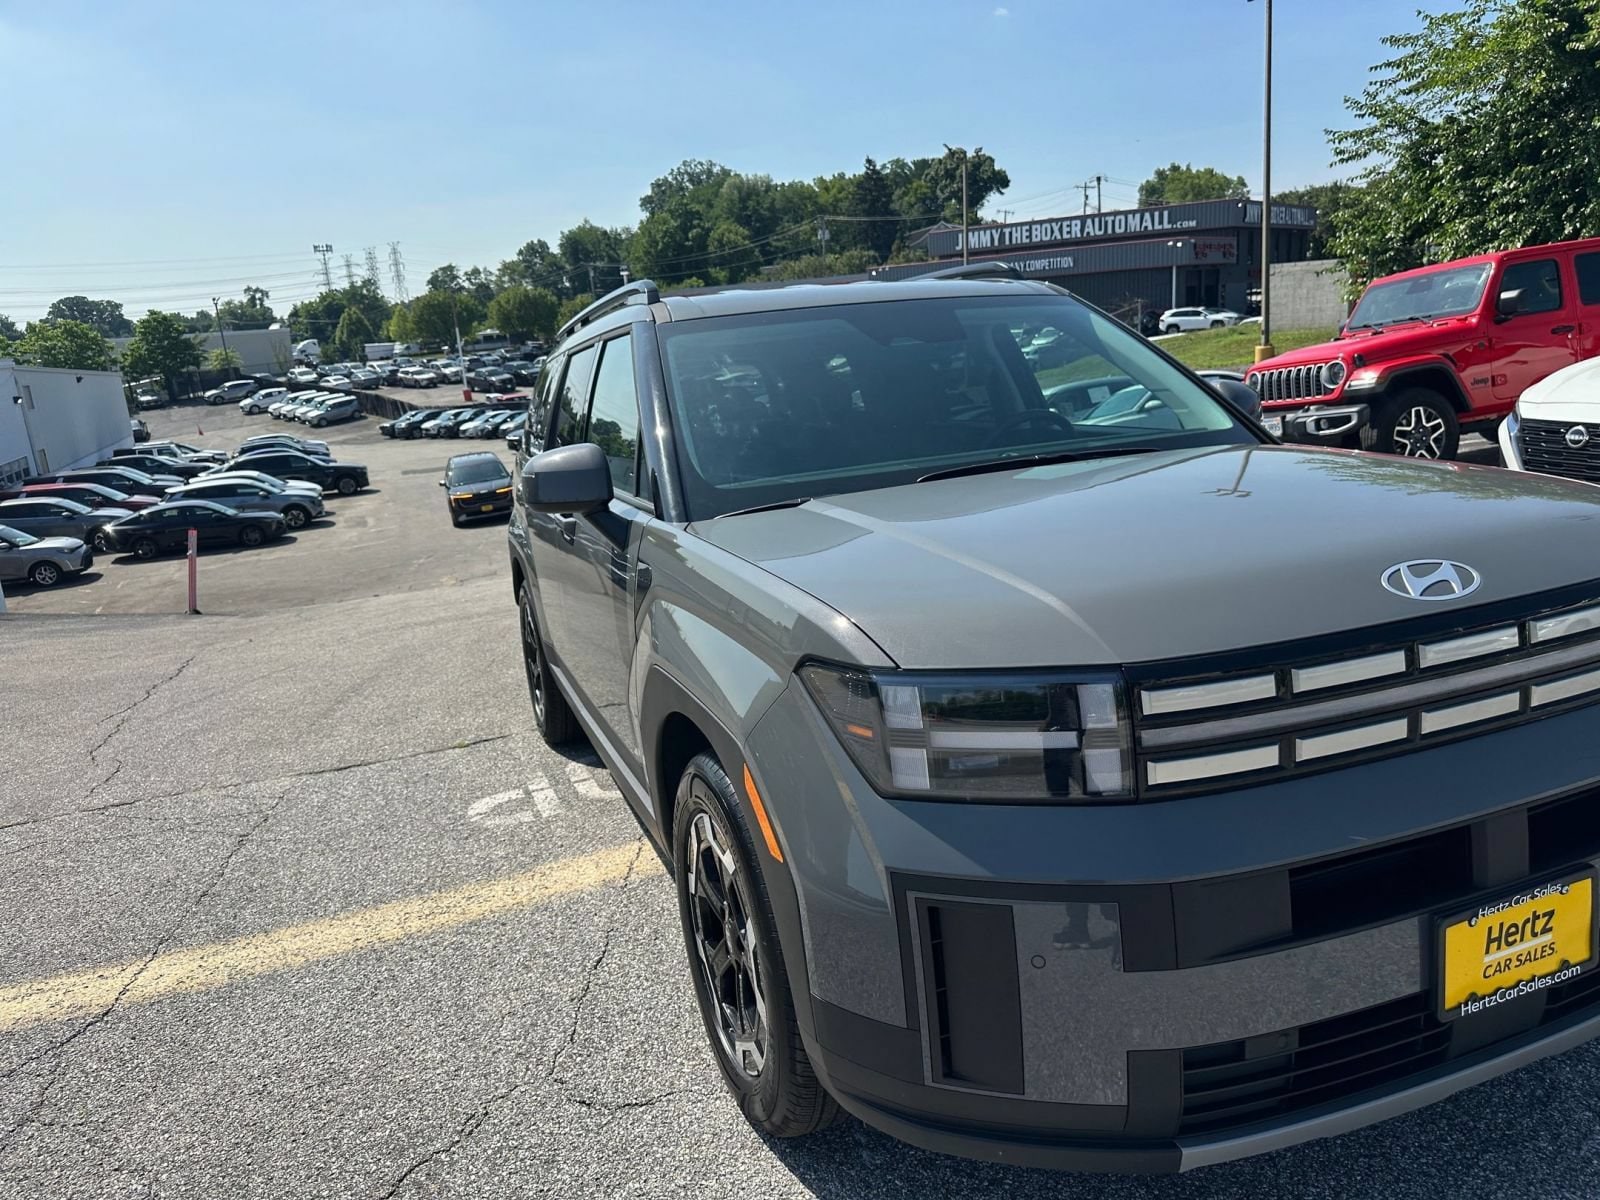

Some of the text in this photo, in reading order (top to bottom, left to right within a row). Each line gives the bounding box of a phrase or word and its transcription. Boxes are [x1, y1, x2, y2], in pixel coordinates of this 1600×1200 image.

[955, 228, 1001, 251] JMMY
[1003, 225, 1030, 246] THE
[1030, 217, 1082, 243] BOXER
[1025, 256, 1075, 272] COMPETITION
[1470, 376, 1490, 386] Jeep
[1478, 883, 1562, 920] Hertz Car Sales
[1484, 909, 1556, 955] Hertz
[1482, 958, 1513, 980] CAR
[1461, 965, 1581, 1017] HertzCarSales.com
